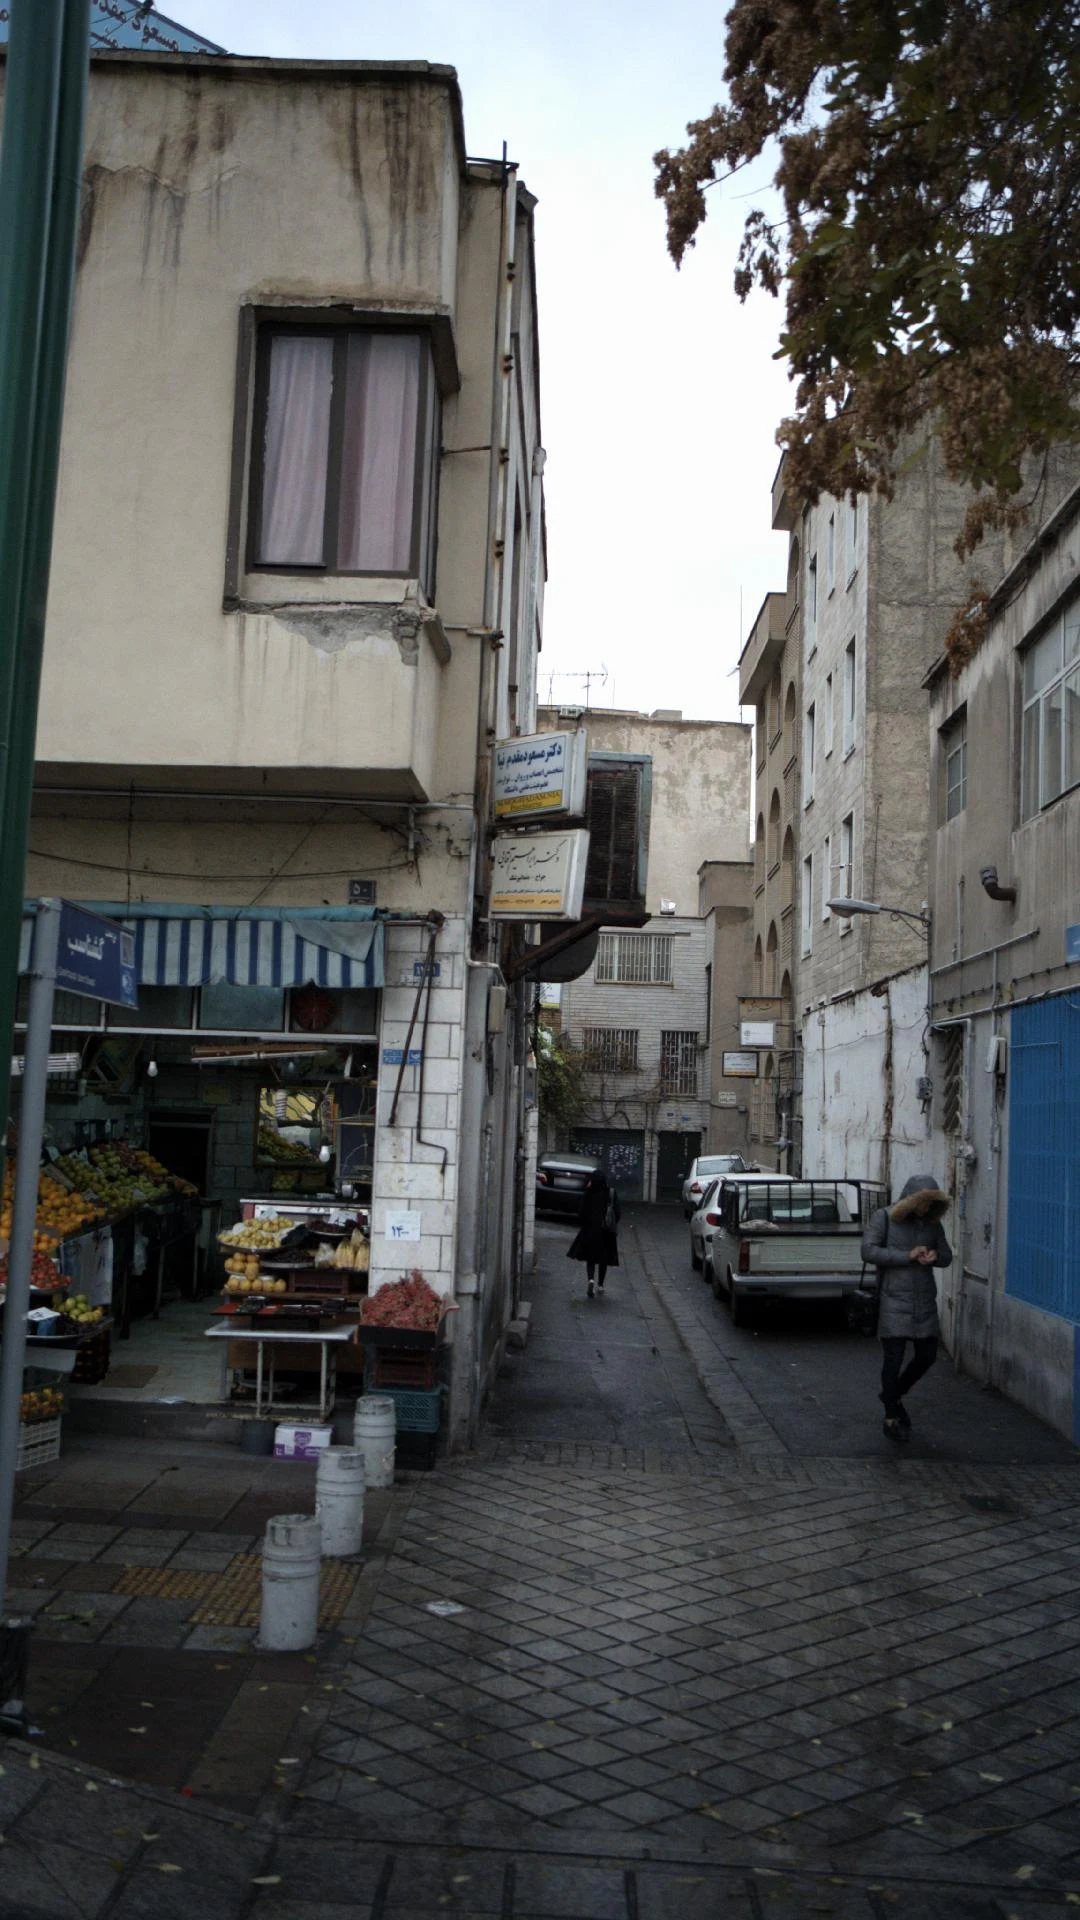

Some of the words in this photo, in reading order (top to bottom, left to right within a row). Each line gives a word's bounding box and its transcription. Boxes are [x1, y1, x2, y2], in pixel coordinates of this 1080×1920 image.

[524, 750, 545, 765] مسعود
[545, 742, 562, 762] دکتر
[534, 839, 567, 866] دکتر
